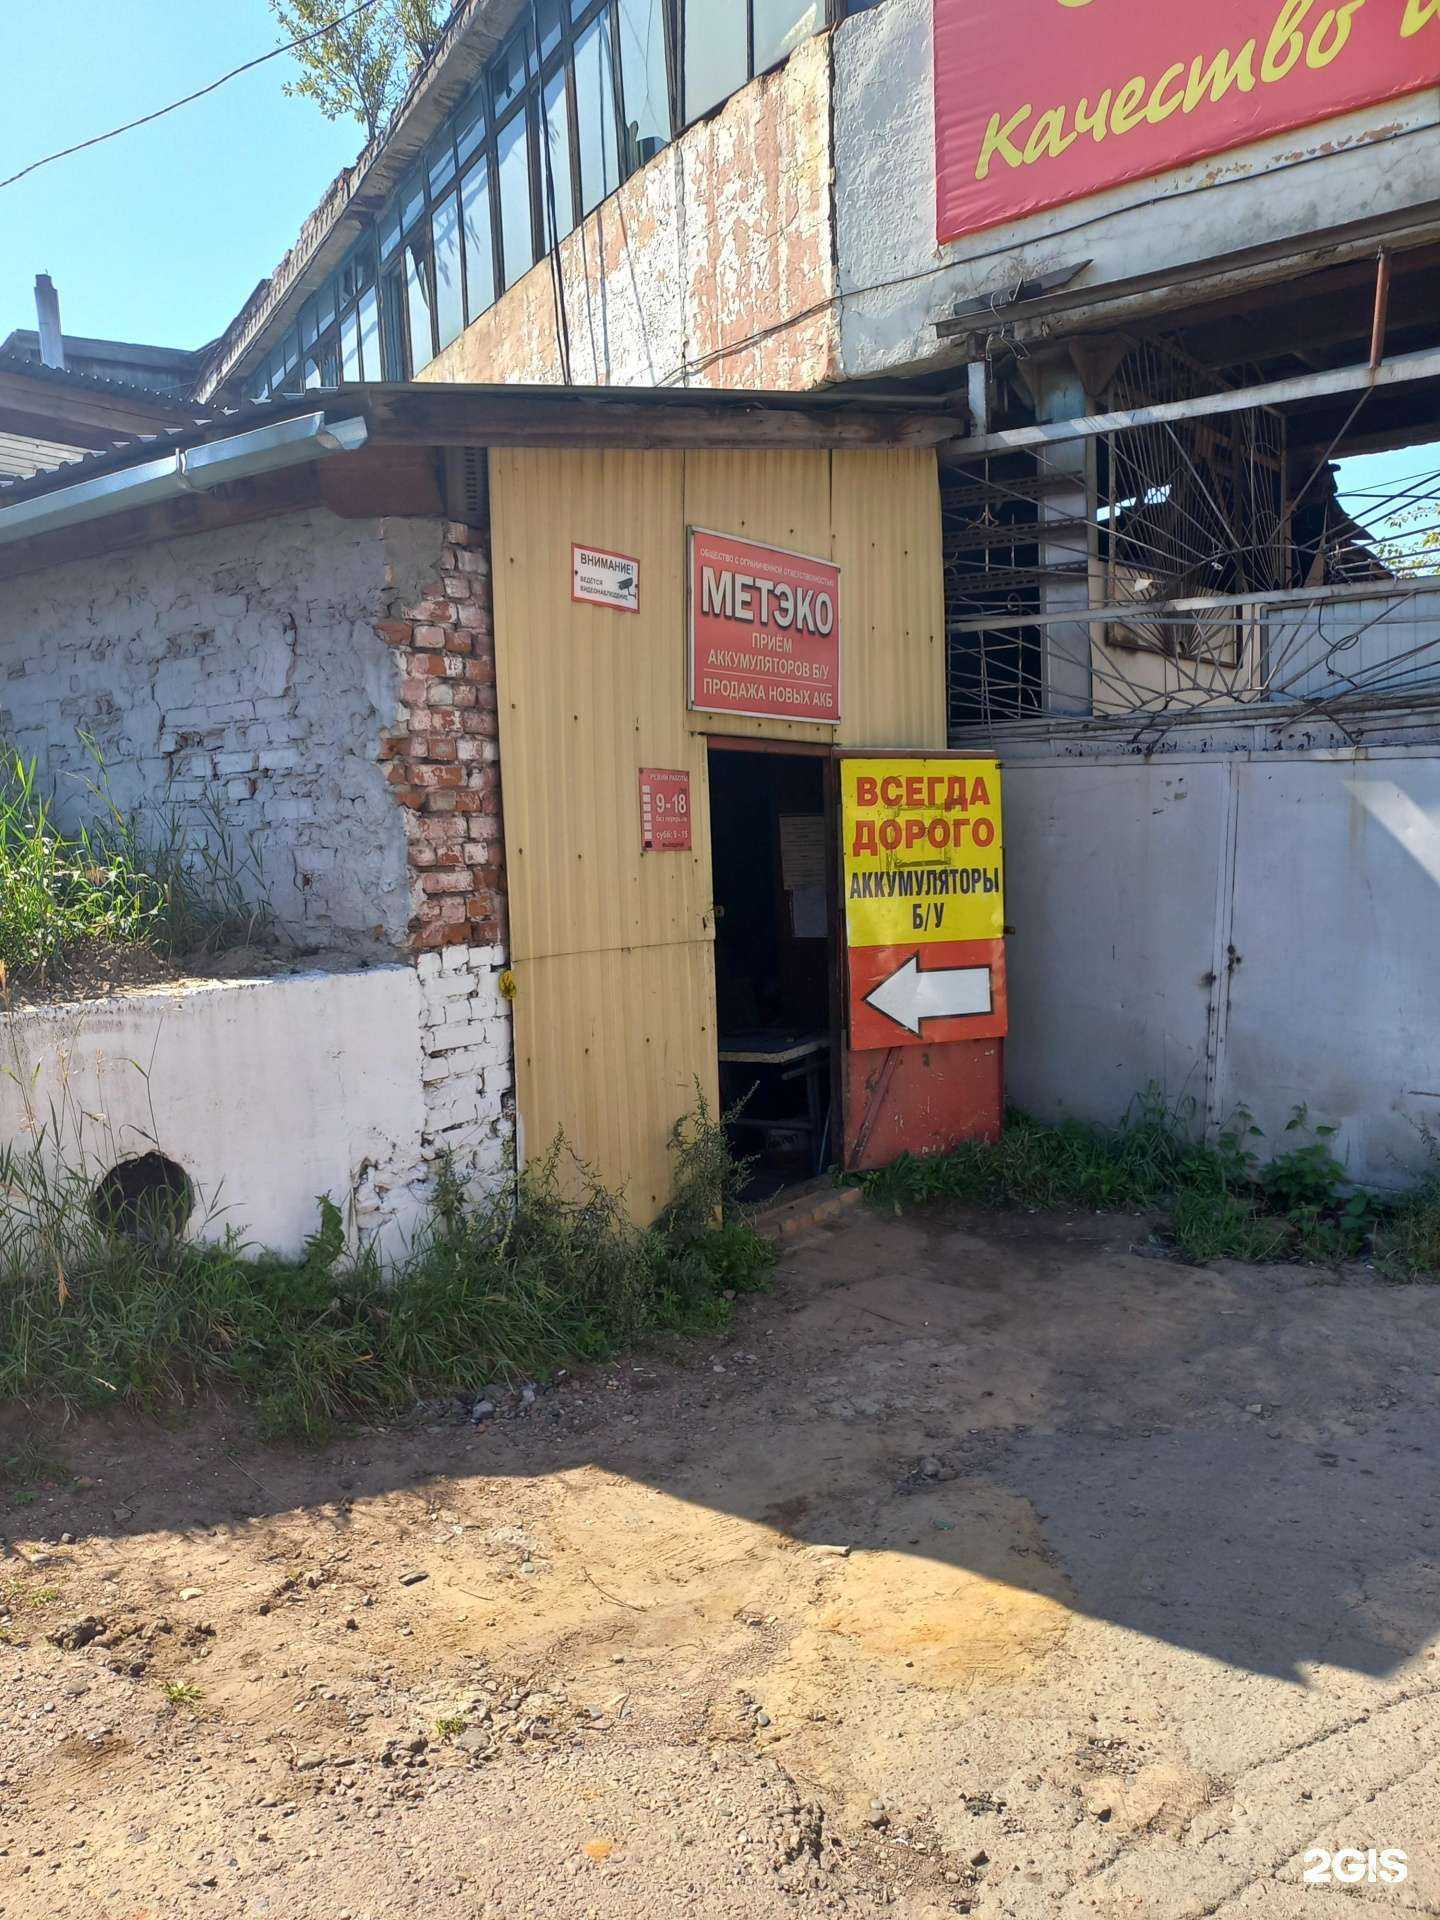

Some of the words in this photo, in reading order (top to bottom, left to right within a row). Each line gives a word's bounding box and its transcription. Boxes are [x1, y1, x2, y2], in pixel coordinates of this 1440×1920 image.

[580, 552, 634, 576] ВНИМАНИЕ!
[702, 565, 834, 636] МЕТЭКО
[752, 632, 793, 654] ПРИЁМ
[708, 650, 810, 677] АККУМУЛЯТОРОВ
[812, 663, 830, 681] Б/У
[703, 678, 766, 700] ПРОДАЖА
[769, 685, 812, 703] НОВЫХ
[812, 690, 833, 708] АКБ
[855, 775, 991, 812] ВСЕГДА
[852, 817, 995, 857] ДОРОГО
[850, 867, 1000, 899] АККУМУЛЯТОРЫ
[912, 902, 945, 932] Б/У
